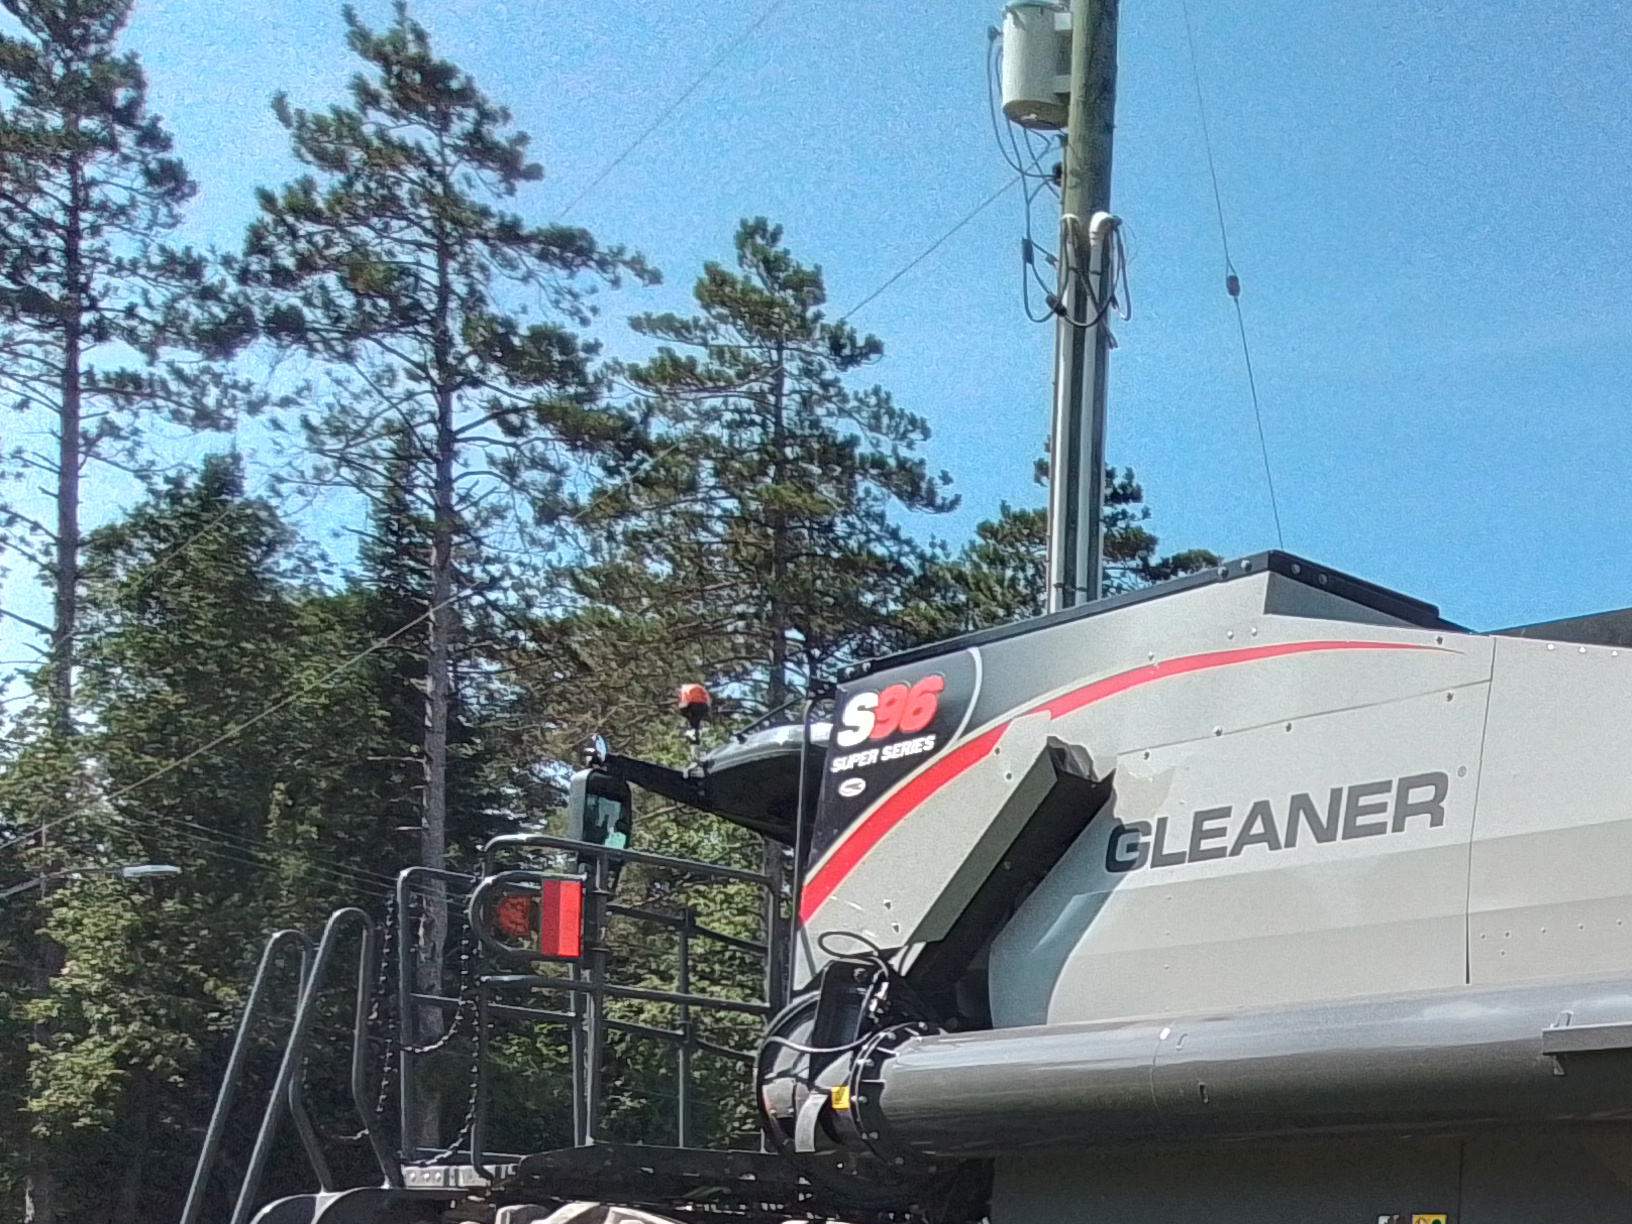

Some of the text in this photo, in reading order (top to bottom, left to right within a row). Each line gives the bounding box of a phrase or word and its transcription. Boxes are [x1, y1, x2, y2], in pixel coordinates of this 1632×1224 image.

[836, 674, 945, 748] S96
[829, 733, 937, 774] SUPER SERIES
[1104, 770, 1450, 875] GLEANER
